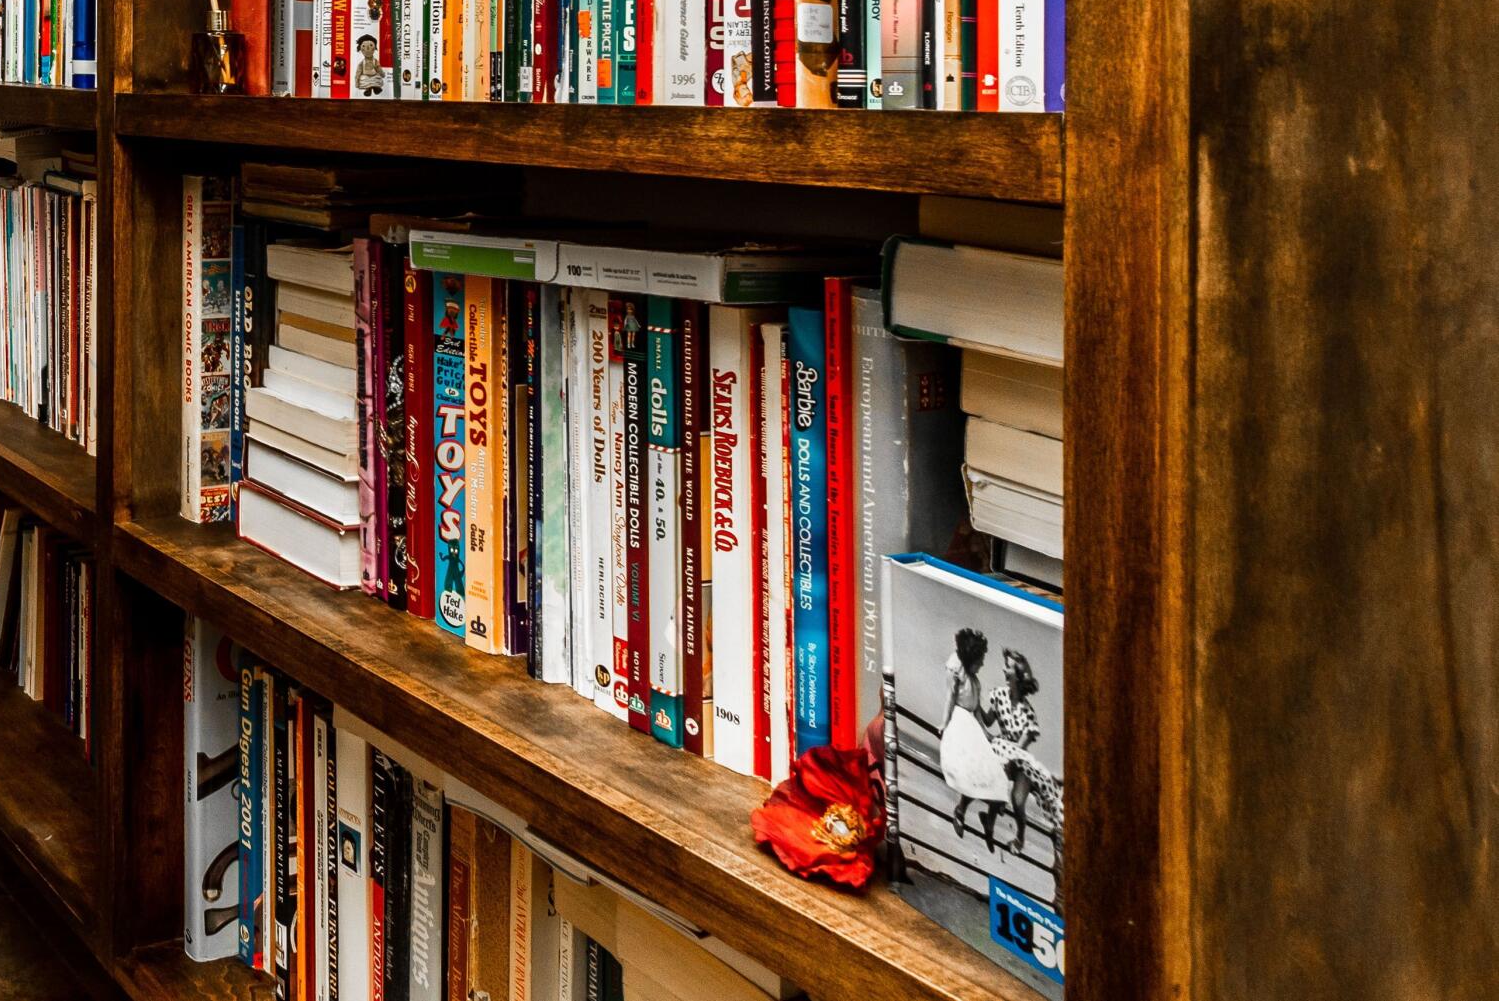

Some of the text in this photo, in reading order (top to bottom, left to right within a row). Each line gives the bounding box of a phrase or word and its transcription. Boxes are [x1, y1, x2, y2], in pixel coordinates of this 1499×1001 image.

[335, 15, 345, 55] PRIMER
[403, 24, 411, 60] GUIDE
[602, 22, 612, 51] PRICE
[678, 26, 688, 61] Guide
[762, 0, 771, 91] ENCYCLOPEDIA
[839, 16, 848, 33] guide
[1014, 5, 1026, 31] Tenth
[1014, 33, 1026, 68] Edition
[671, 73, 696, 85] 1996
[185, 195, 193, 403] GREAT AMERICAN COMIC BOOKS
[467, 303, 478, 362] Collectible
[470, 362, 488, 446] TOYS
[592, 330, 606, 483] 200 Years of Dolls
[651, 377, 668, 436] dolls
[684, 320, 693, 520] CELLULOID DOLLS OF THE WORLD
[405, 416, 420, 519] Old Jewelry
[436, 404, 466, 541] TOYS
[613, 432, 625, 508] Nancy Ann
[627, 362, 640, 548] MODERN COLLECTIBLE DOLLS
[714, 431, 738, 509] ROEBUCK
[795, 361, 818, 610] Barbie DOLLS AND COLLECTIBLES
[859, 356, 876, 592] European and American
[469, 523, 478, 552] Guide
[477, 529, 485, 552] Price
[443, 605, 464, 622] Hake
[444, 594, 461, 609] Ted
[685, 548, 694, 655] MARJORY FAINGES
[715, 706, 740, 725] 1908
[239, 668, 252, 851] Gun Digest 2001
[276, 748, 284, 903] AMERICAN FURNITURE
[327, 760, 337, 875] GOLDEN OAK
[412, 862, 435, 989] Antiques
